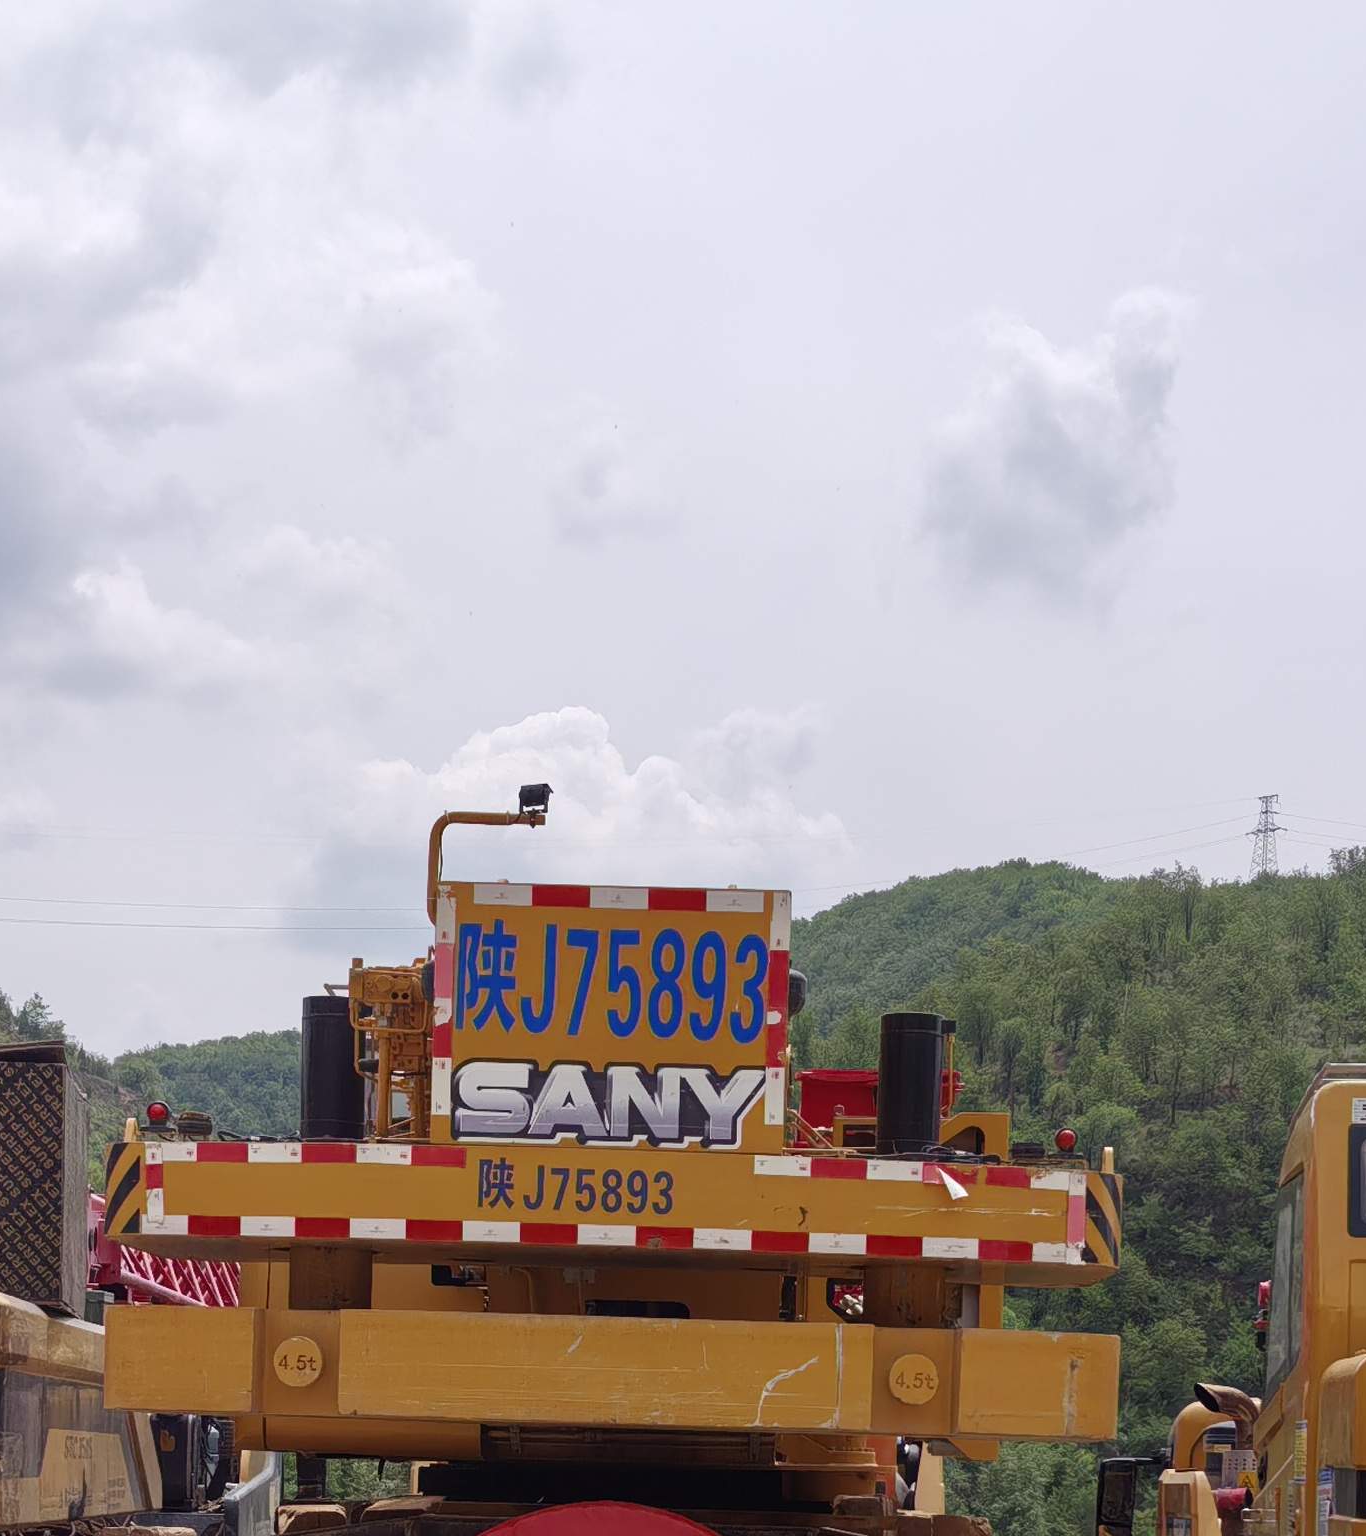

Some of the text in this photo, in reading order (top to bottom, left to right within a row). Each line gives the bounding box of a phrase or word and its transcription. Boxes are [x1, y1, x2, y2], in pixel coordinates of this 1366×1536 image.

[454, 918, 769, 1044] 陕J75893
[455, 1060, 767, 1145] SANY
[477, 1157, 675, 1216] 陕J75893
[278, 1352, 317, 1373] 4.5t
[894, 1371, 935, 1391] 4.5t
